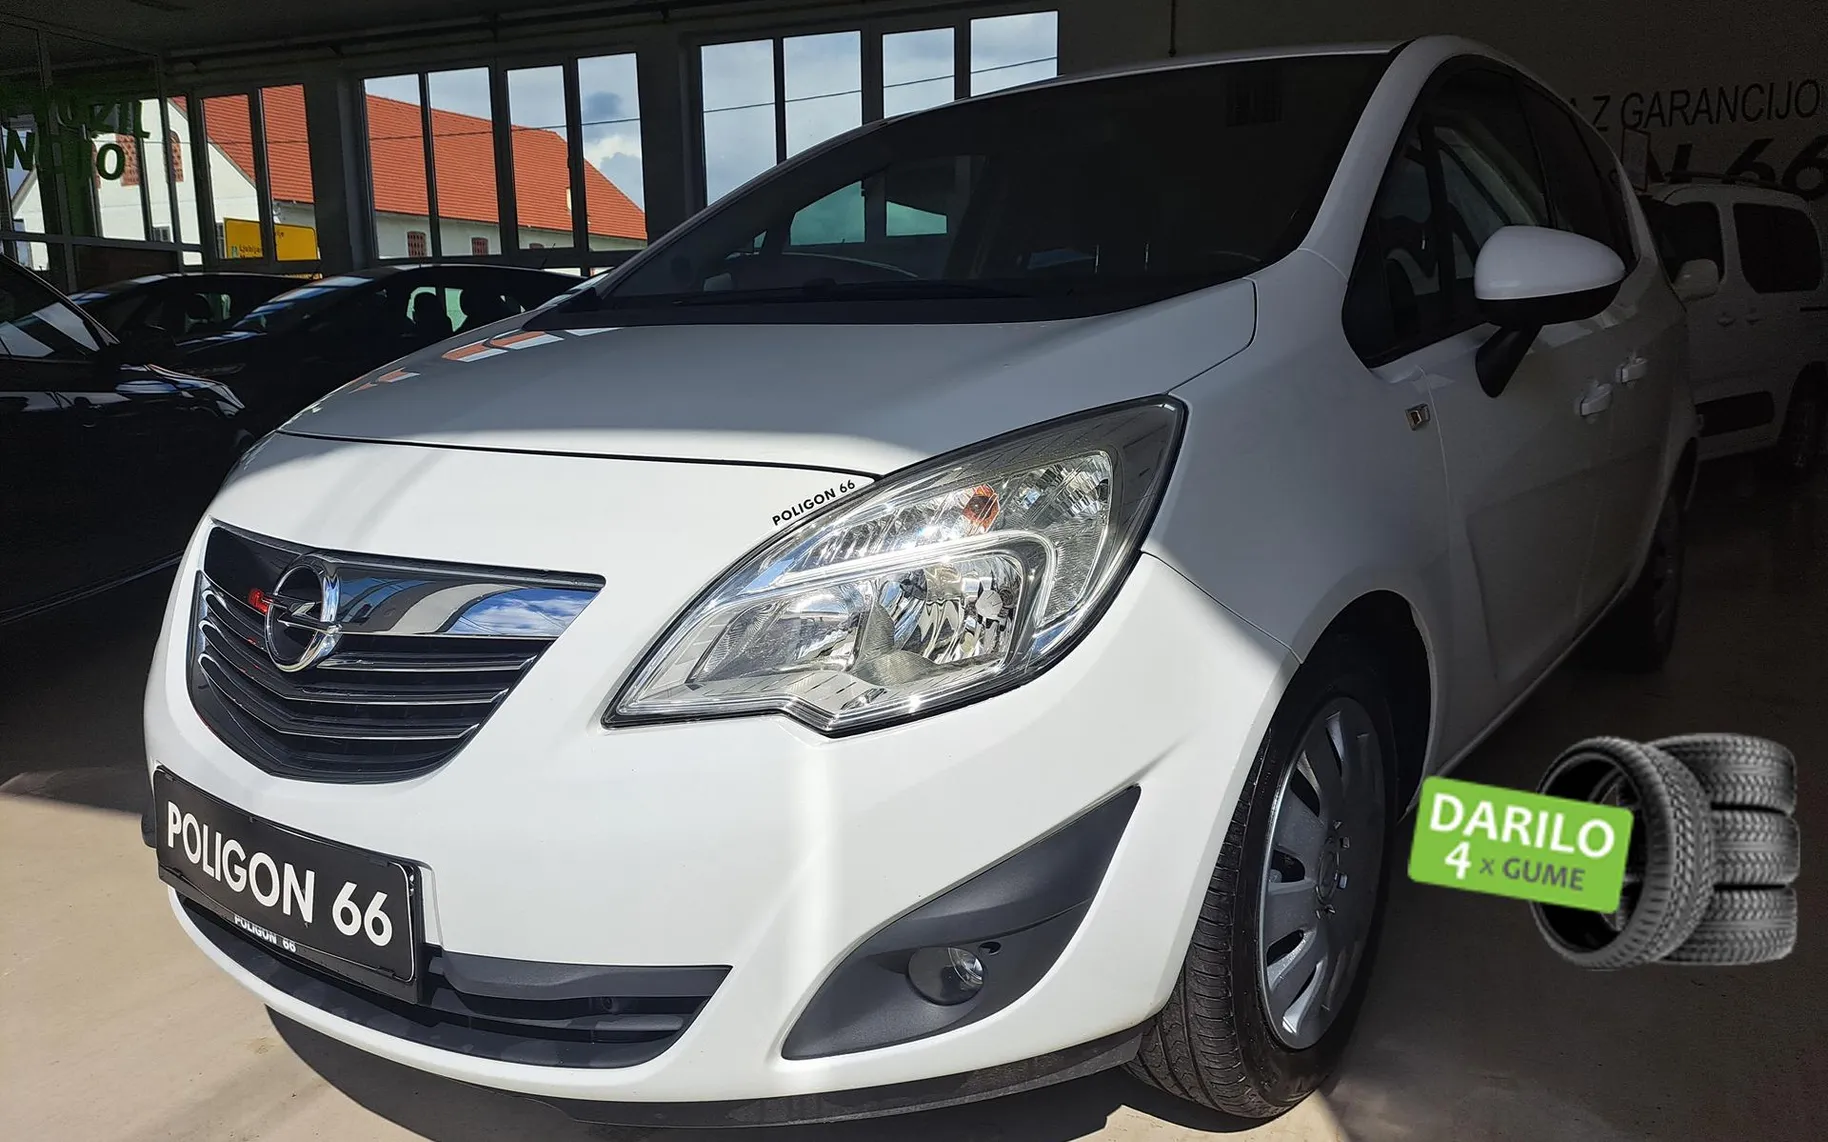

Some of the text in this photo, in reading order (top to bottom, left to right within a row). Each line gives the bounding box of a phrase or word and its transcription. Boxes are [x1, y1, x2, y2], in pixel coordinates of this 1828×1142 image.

[1620, 79, 1821, 129] GARANCIJO
[772, 479, 856, 526] POLIGON 66
[167, 801, 393, 947] POLIGON 66
[234, 914, 297, 953] POLIGON 66
